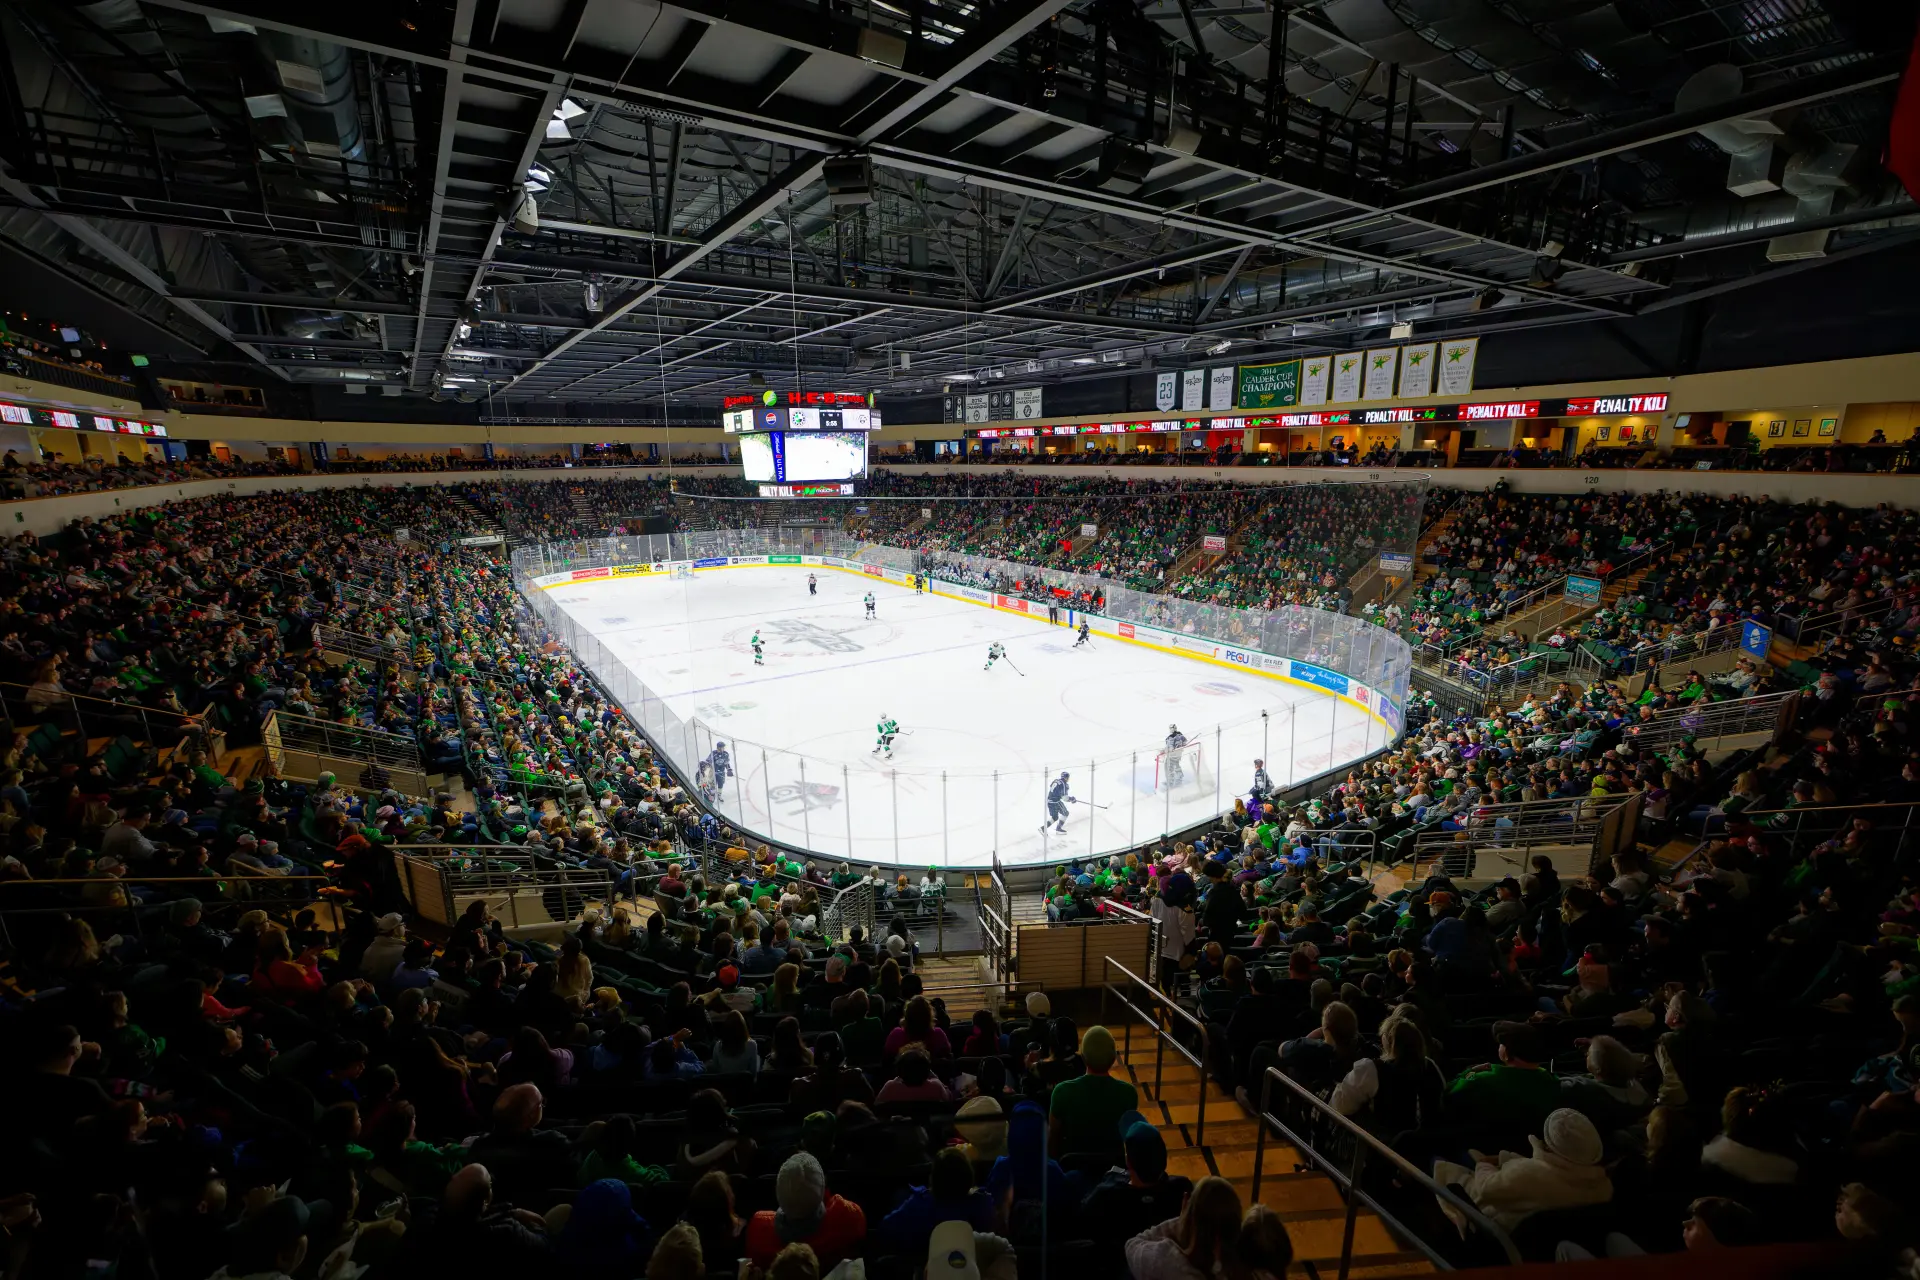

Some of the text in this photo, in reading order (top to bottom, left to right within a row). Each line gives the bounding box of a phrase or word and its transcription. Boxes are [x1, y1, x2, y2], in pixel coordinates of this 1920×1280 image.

[1245, 371, 1293, 384] CALDER CUP
[1260, 367, 1277, 376] 2014
[1159, 382, 1173, 399] 23
[1241, 379, 1296, 393] CHAMPIONS
[1593, 397, 1643, 413] PENALTY
[1365, 410, 1414, 423] PENALTY KILL
[1466, 404, 1527, 419] PENALTY KILL
[1151, 421, 1181, 431] PENALTY KILL
[1210, 418, 1246, 429] PENALTY KILL
[1281, 414, 1322, 426] PENALTY KILL
[1054, 427, 1069, 435] PENALTY
[1099, 424, 1126, 434] PENALTY KILL
[1584, 475, 1599, 484] 120
[778, 485, 795, 497] KILL
[961, 588, 988, 601] ticketmaster
